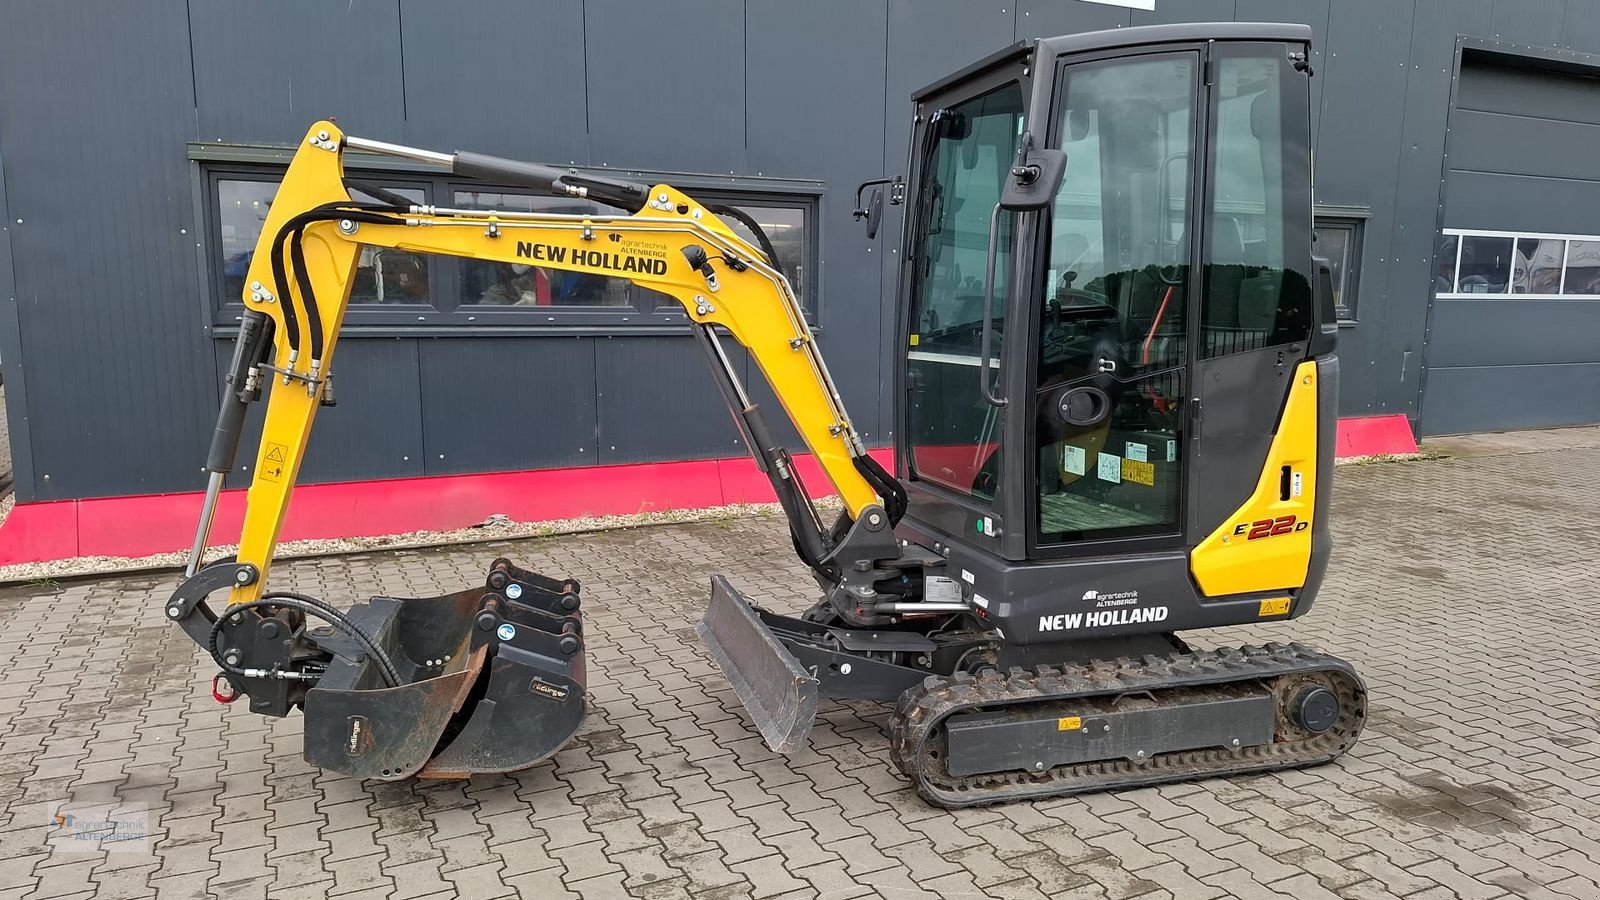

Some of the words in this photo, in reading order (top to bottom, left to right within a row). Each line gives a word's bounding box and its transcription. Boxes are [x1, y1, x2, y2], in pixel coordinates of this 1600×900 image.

[621, 238, 668, 251] agrartechnik
[516, 241, 567, 263] NEW
[571, 248, 668, 276] HOLLAND
[620, 247, 668, 258] ALTENBERGE
[1097, 590, 1138, 601] agrartechnik
[1096, 598, 1138, 608] ALTENBERGE
[1038, 612, 1083, 632] NEW
[1085, 606, 1169, 628] HOLLAND
